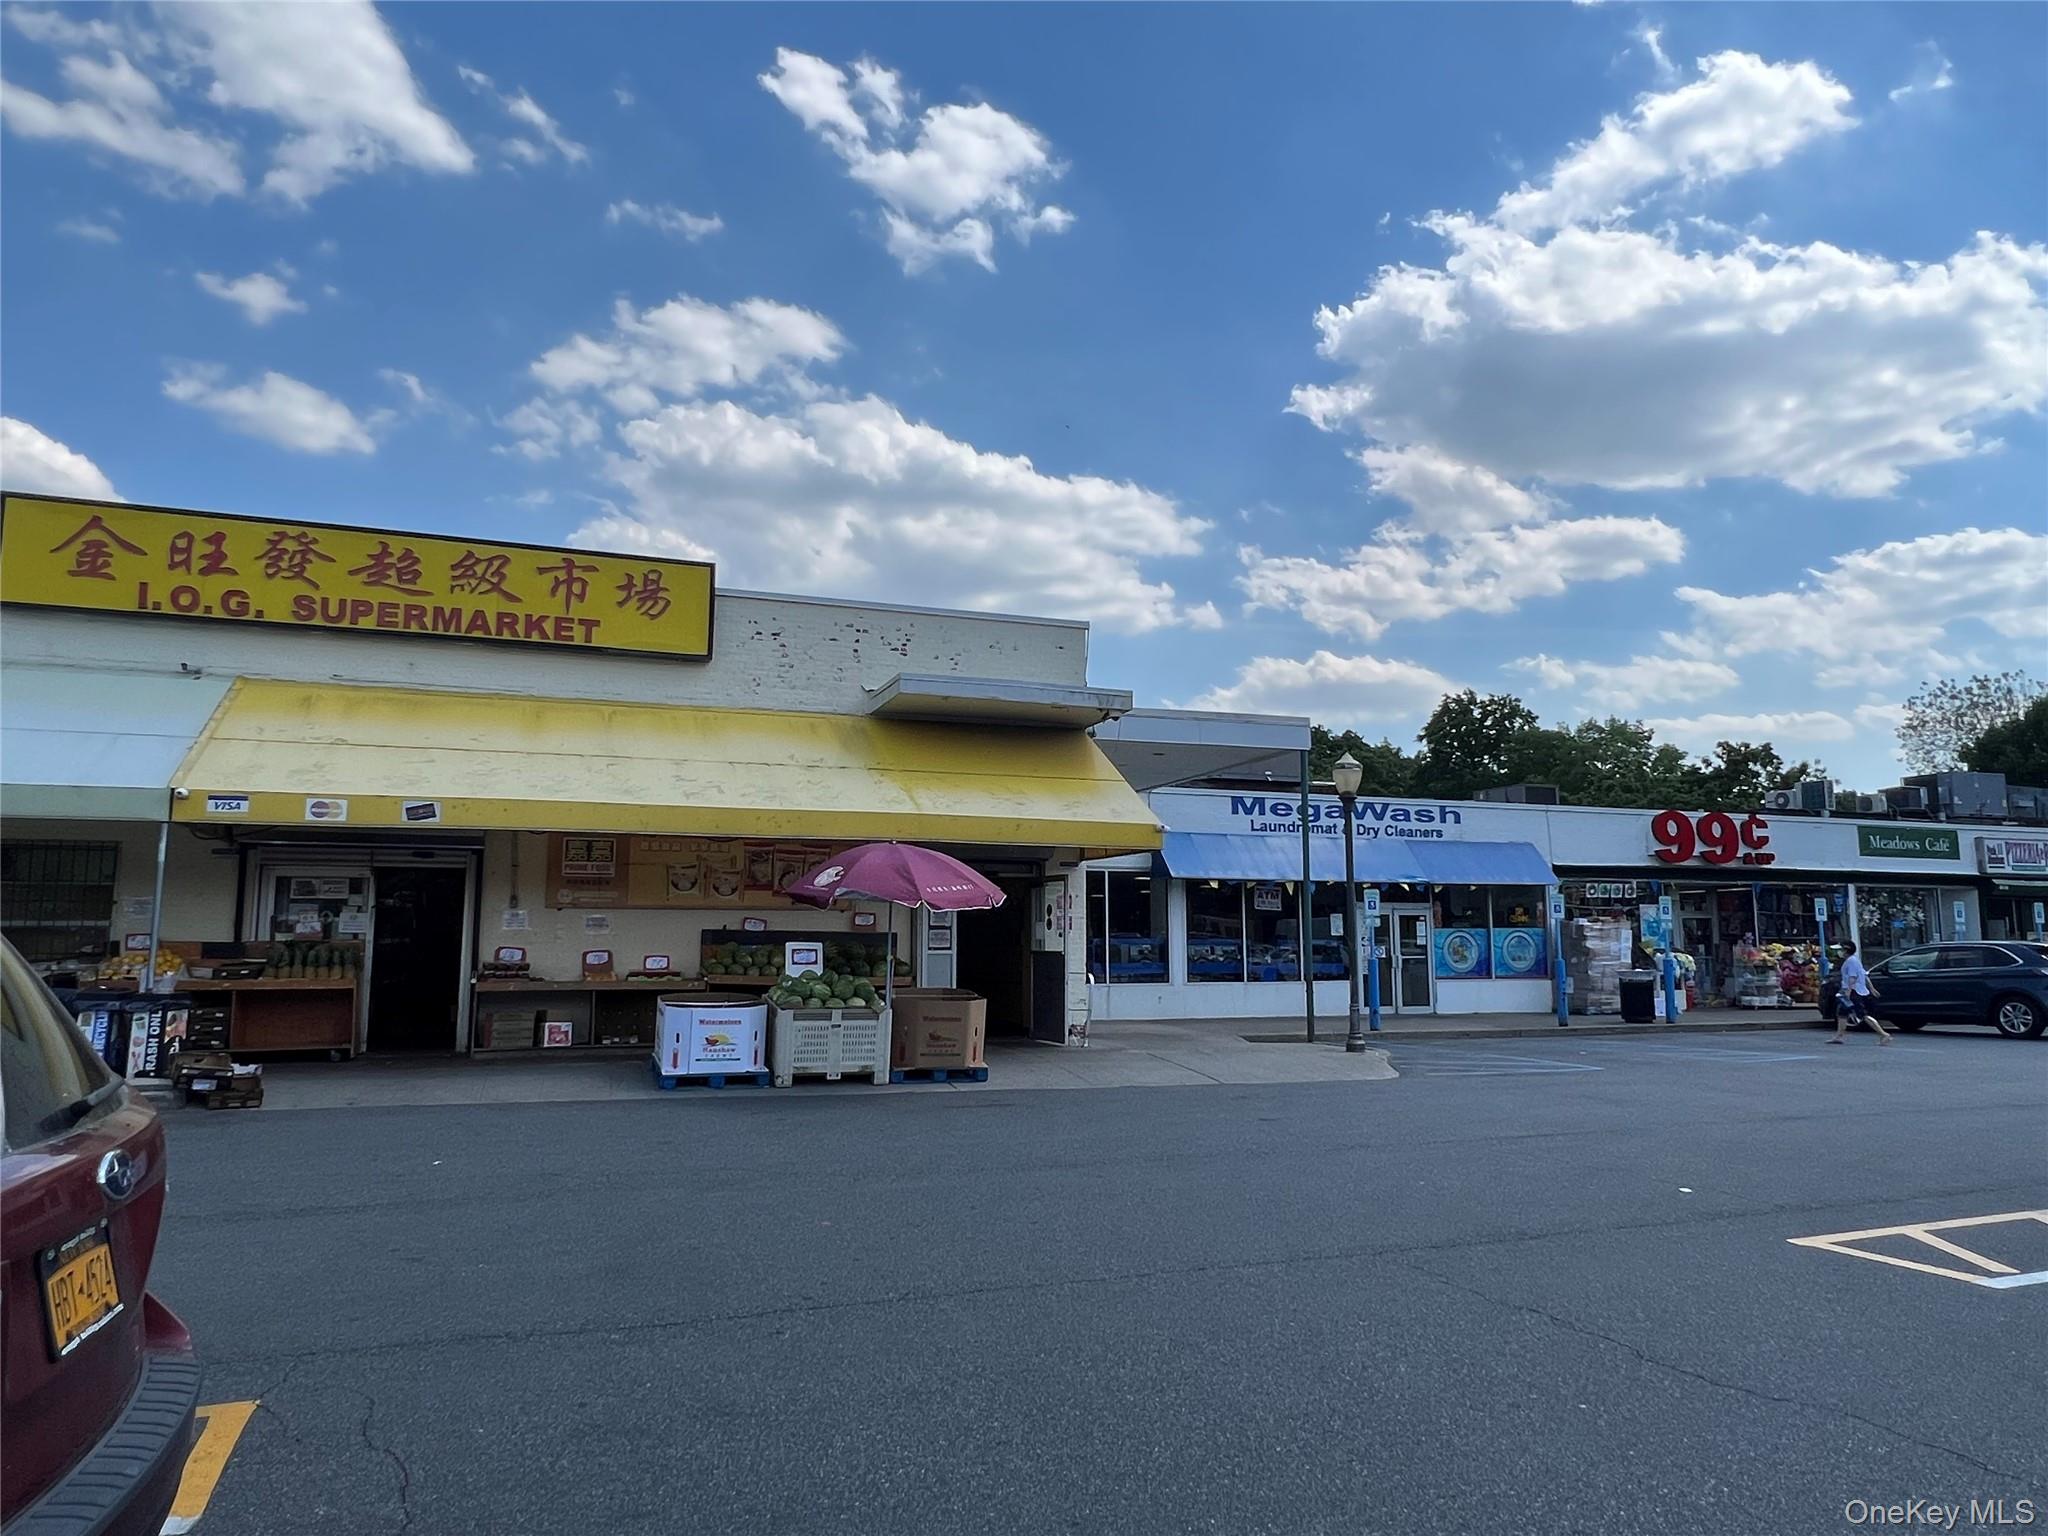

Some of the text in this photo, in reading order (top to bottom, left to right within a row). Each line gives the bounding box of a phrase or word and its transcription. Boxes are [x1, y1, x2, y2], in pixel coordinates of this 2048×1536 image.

[50, 515, 672, 620] 金旺發超級市場
[137, 581, 601, 644] I.O.G. SUPERMARKET
[213, 801, 242, 811] VISA
[1231, 796, 1462, 825] MegaWash
[1356, 823, 1380, 840] Dry
[1384, 824, 1444, 839] Cleaners
[1868, 835, 1921, 850] Meadows
[1257, 890, 1280, 900] ATM
[145, 1009, 163, 1076] RASH ONL
